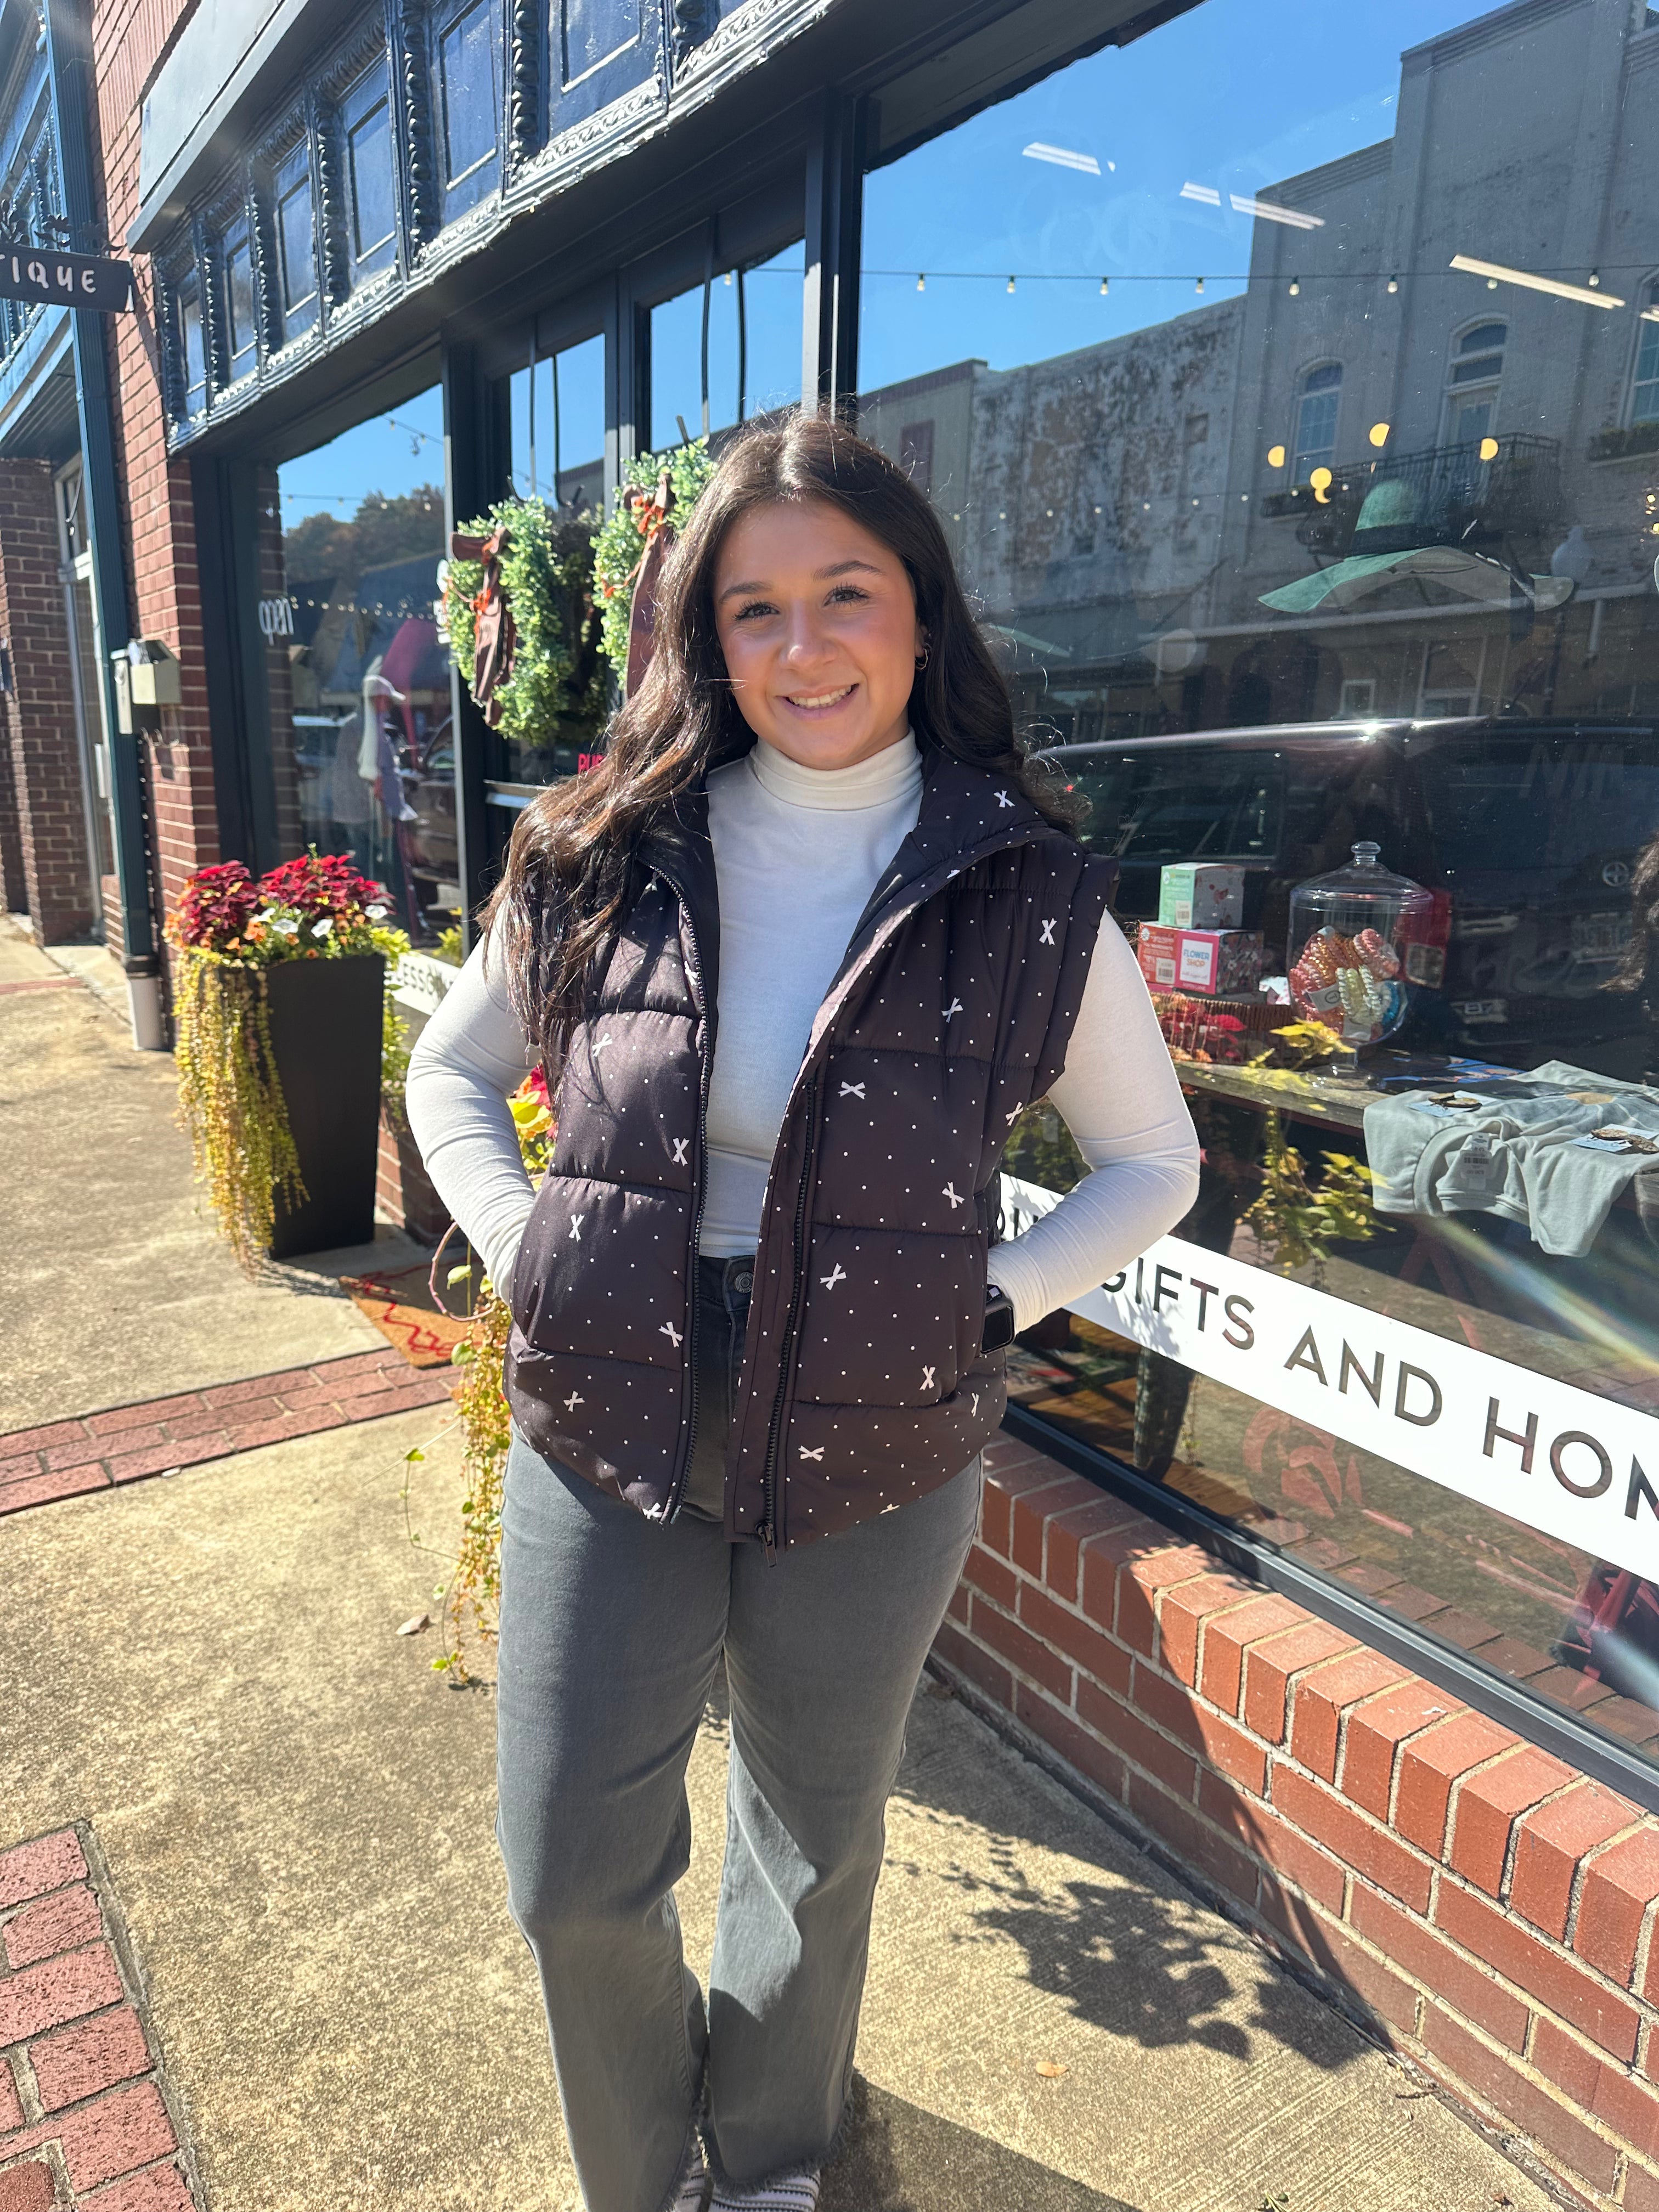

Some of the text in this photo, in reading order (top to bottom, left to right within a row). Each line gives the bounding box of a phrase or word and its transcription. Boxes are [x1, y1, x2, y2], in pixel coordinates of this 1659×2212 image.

[0, 253, 97, 294] IQUE
[258, 598, 294, 647] open
[1183, 949, 1210, 961] FLOWER
[1186, 957, 1205, 967] SHOP
[1283, 1325, 1443, 1427] AND
